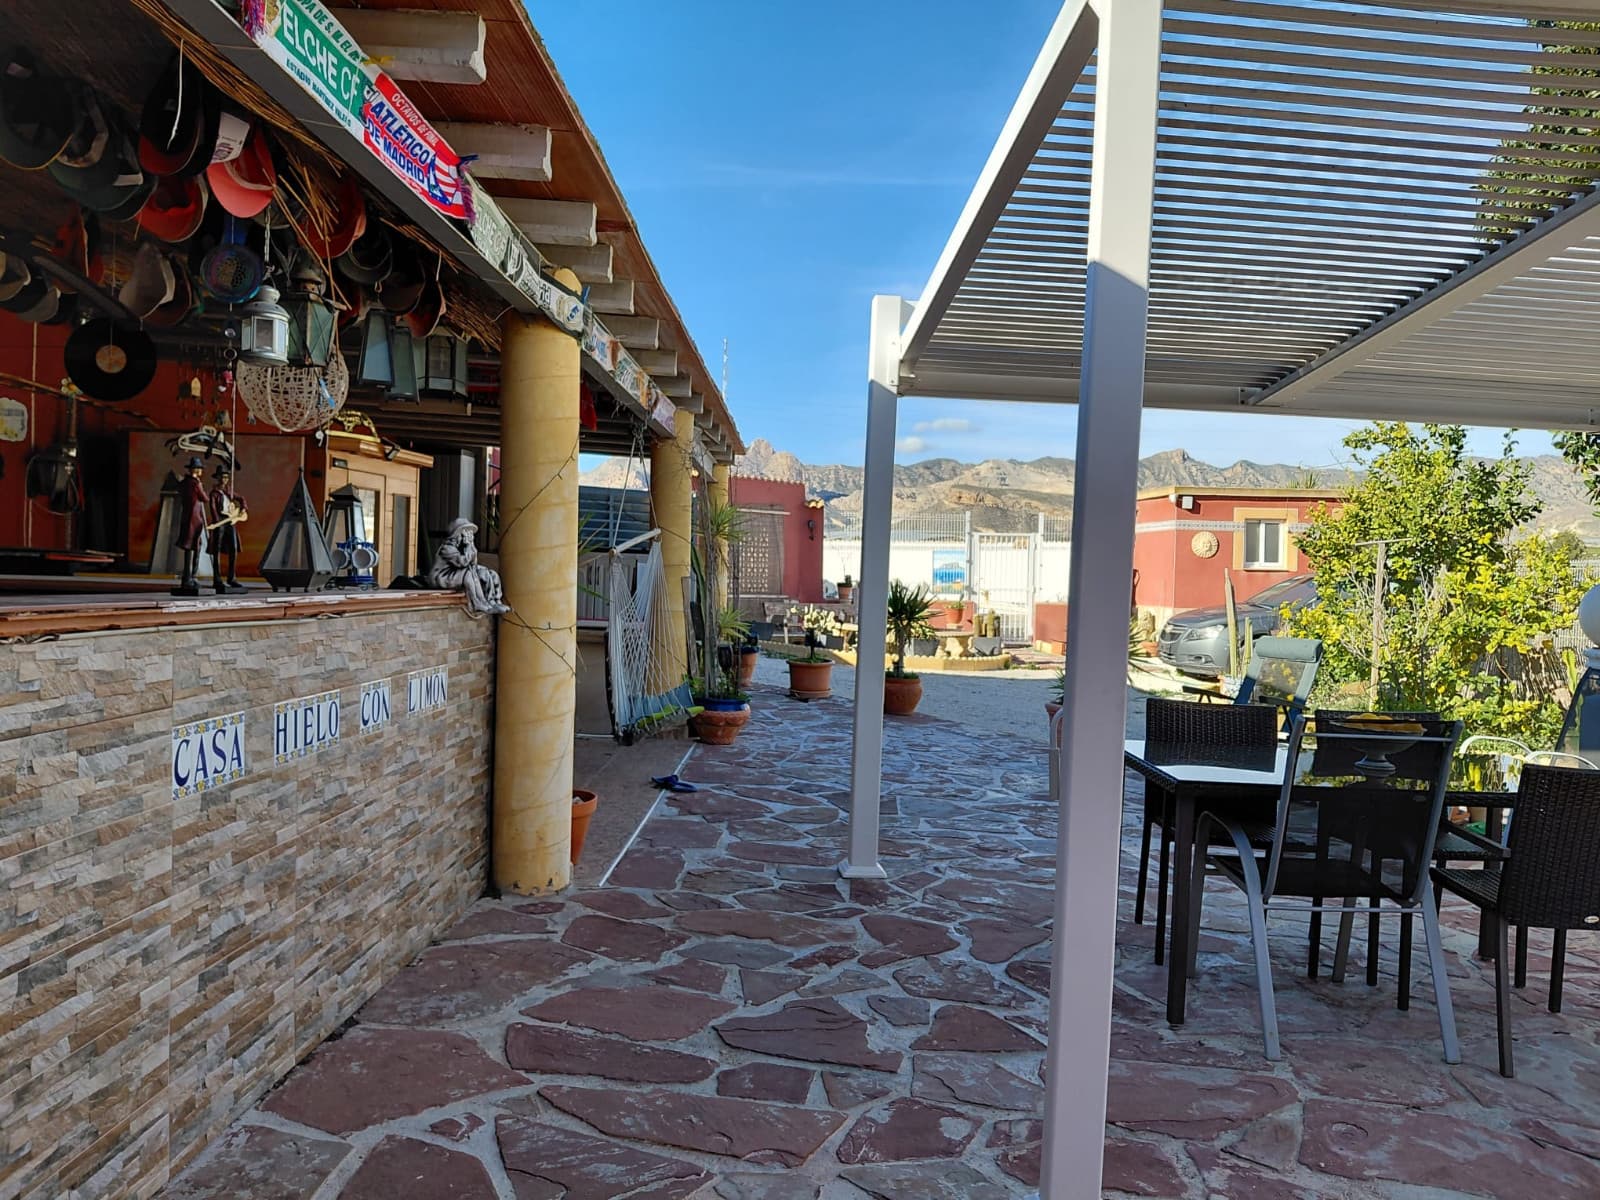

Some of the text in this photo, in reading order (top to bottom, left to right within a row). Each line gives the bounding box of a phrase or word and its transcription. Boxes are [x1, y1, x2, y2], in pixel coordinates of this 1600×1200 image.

[283, 4, 338, 91] ELCHE
[313, 9, 328, 24] DE
[371, 101, 430, 165] ATLÉTICO
[392, 93, 420, 126] OCTAVOS
[367, 118, 381, 145] DE
[383, 136, 425, 184] MADRID
[174, 674, 446, 787] CASA HIELO CON LIMON
